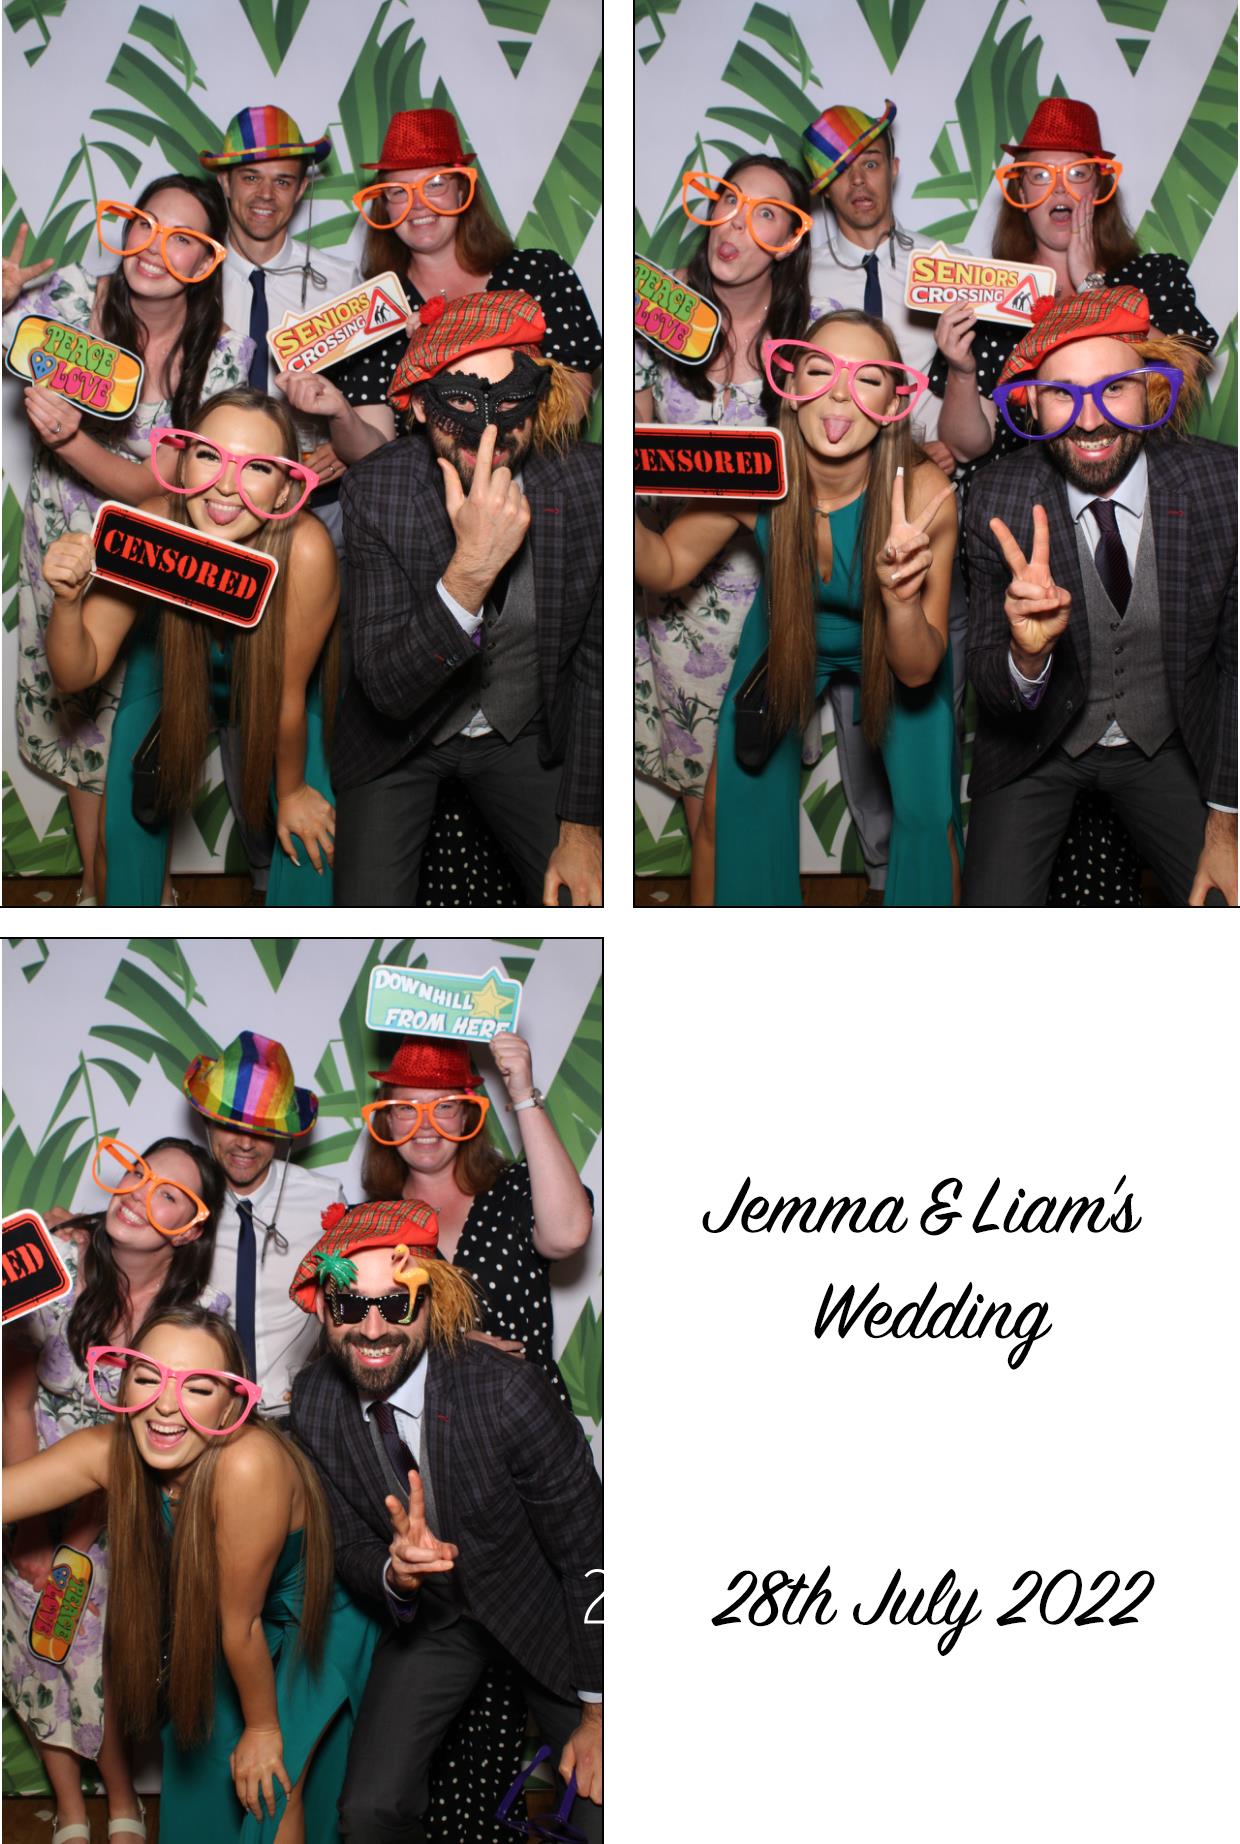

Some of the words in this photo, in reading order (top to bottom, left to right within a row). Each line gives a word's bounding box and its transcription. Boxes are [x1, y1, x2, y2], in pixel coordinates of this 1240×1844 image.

[635, 263, 698, 322] PEACE
[910, 286, 1005, 303] CROSSING
[911, 256, 1019, 288] SENIORS
[273, 292, 371, 359] SENIORS
[287, 314, 367, 373] CROSSING
[635, 298, 691, 351] LOVE
[43, 325, 117, 378] PEACE
[50, 360, 113, 408] LOVE
[635, 448, 772, 475] ENSORED
[103, 528, 258, 602] CENSORED
[374, 969, 475, 1011] DOWNHILL
[384, 1007, 448, 1033] FROM
[33, 1582, 64, 1637] LOVE
[53, 1578, 86, 1641] PEACE
